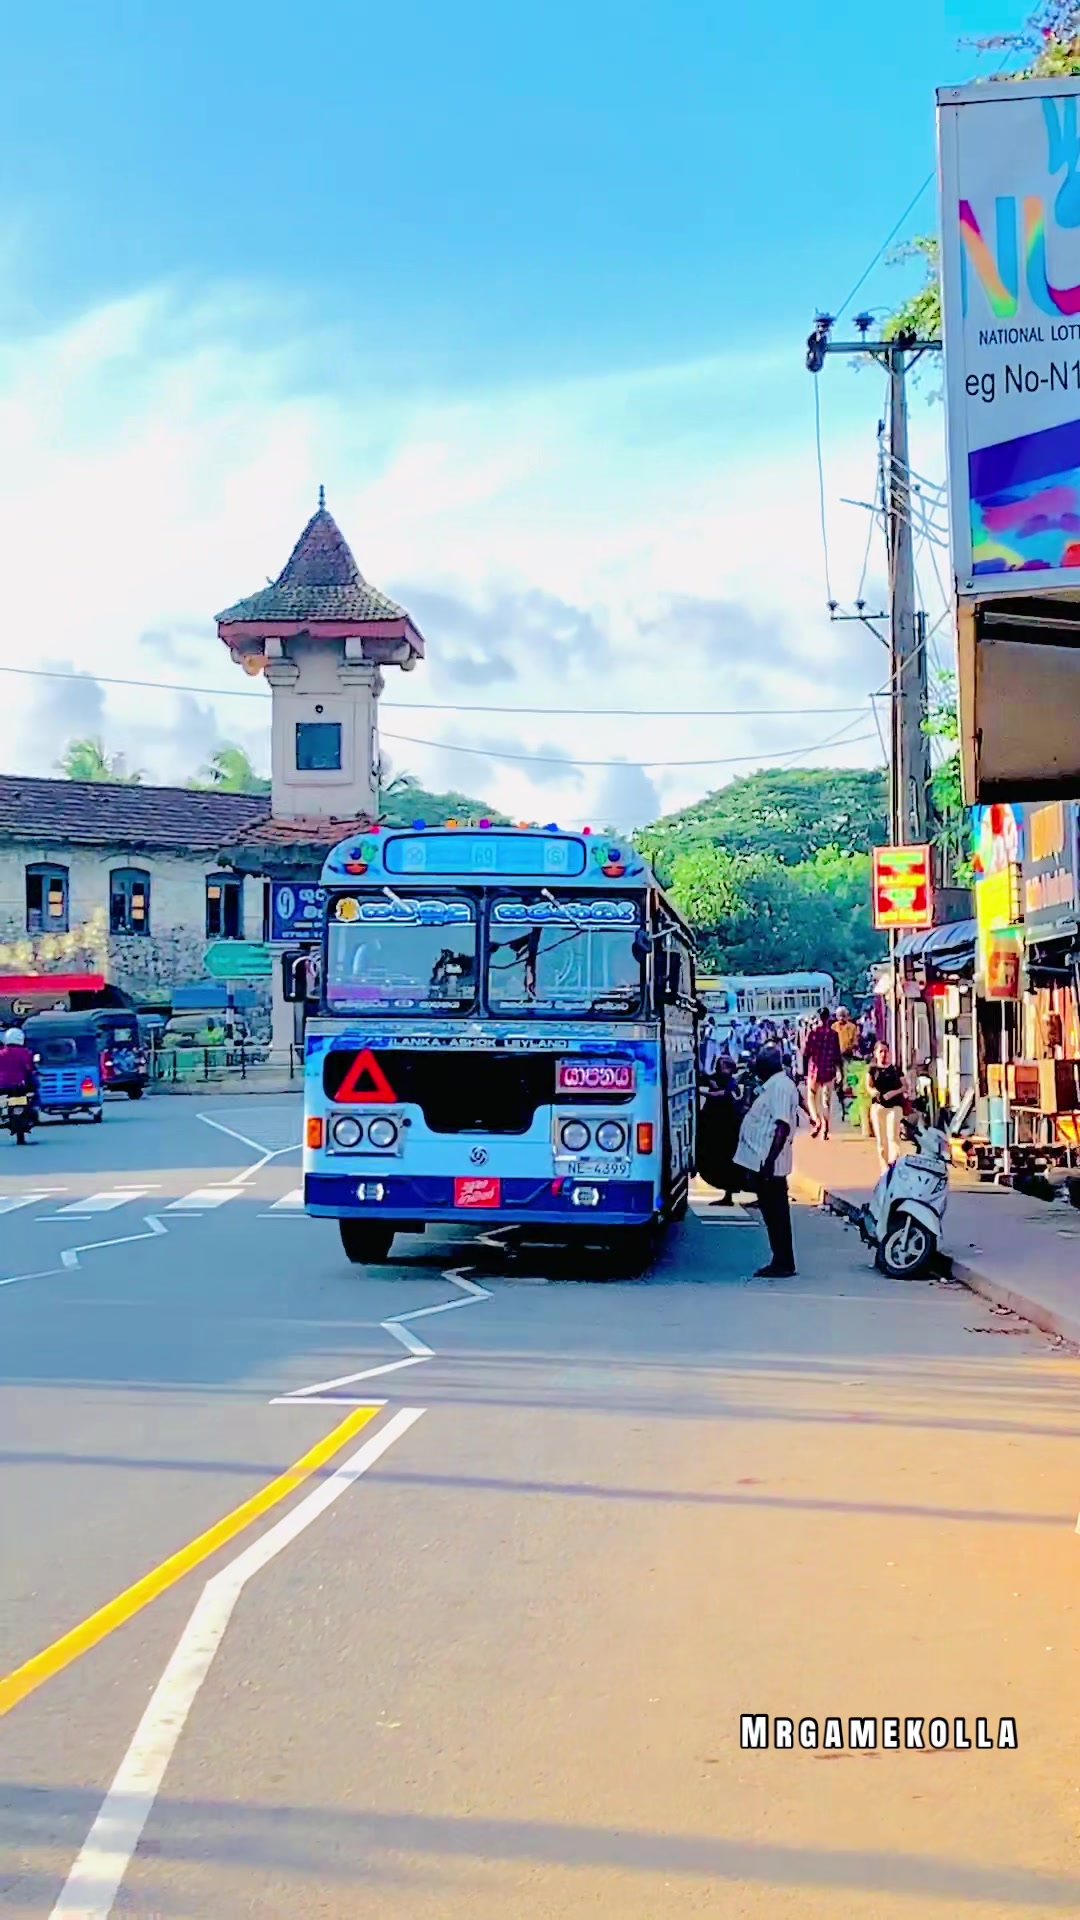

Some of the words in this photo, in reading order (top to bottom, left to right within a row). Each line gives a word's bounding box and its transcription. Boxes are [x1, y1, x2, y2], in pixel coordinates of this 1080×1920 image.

[979, 327, 1044, 346] NATIONAL
[393, 1037, 441, 1048] LANKA
[450, 1038, 496, 1048] ASHOK
[504, 1039, 567, 1049] LEYLAND
[568, 1162, 626, 1175] NE-4399
